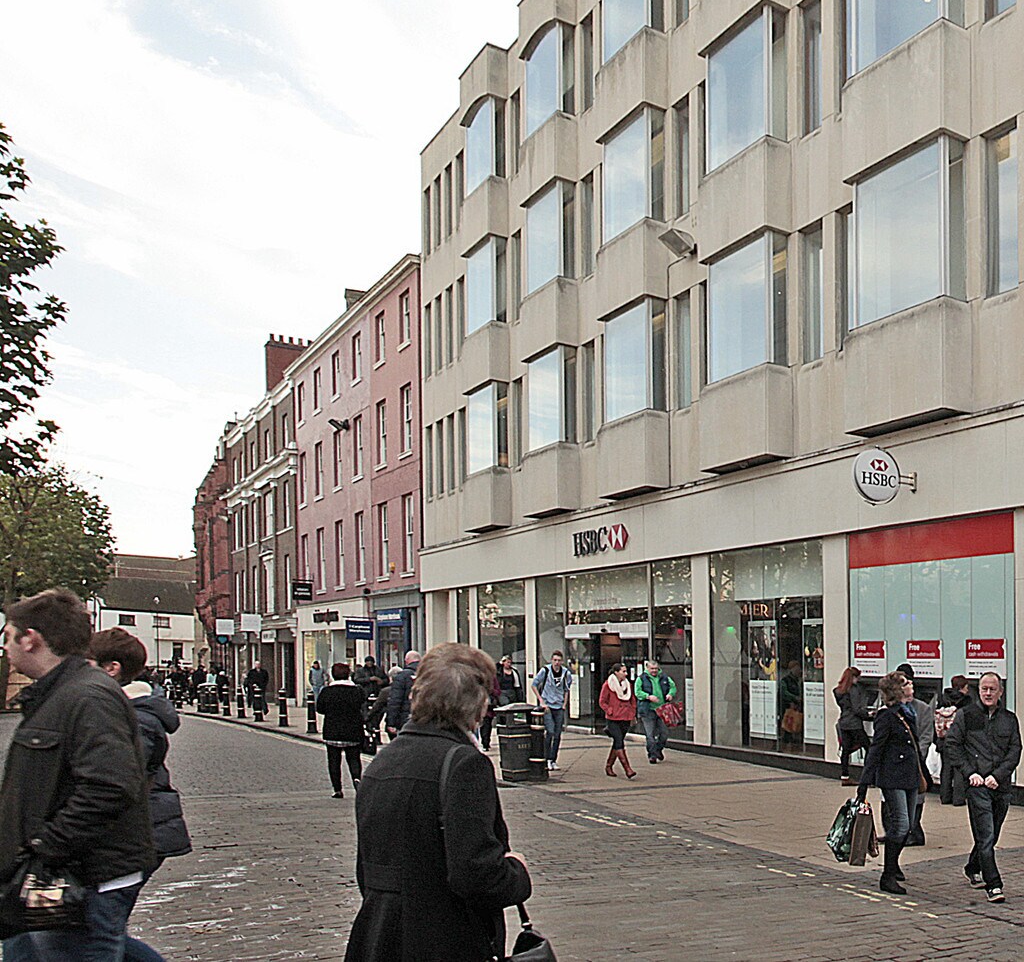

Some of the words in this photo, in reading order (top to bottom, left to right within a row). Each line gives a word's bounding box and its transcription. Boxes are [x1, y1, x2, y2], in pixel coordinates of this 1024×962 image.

[861, 471, 897, 488] HSBC
[572, 526, 608, 556] HSBC
[855, 643, 867, 651] Free
[908, 643, 920, 651] Free
[968, 642, 981, 650] Free
